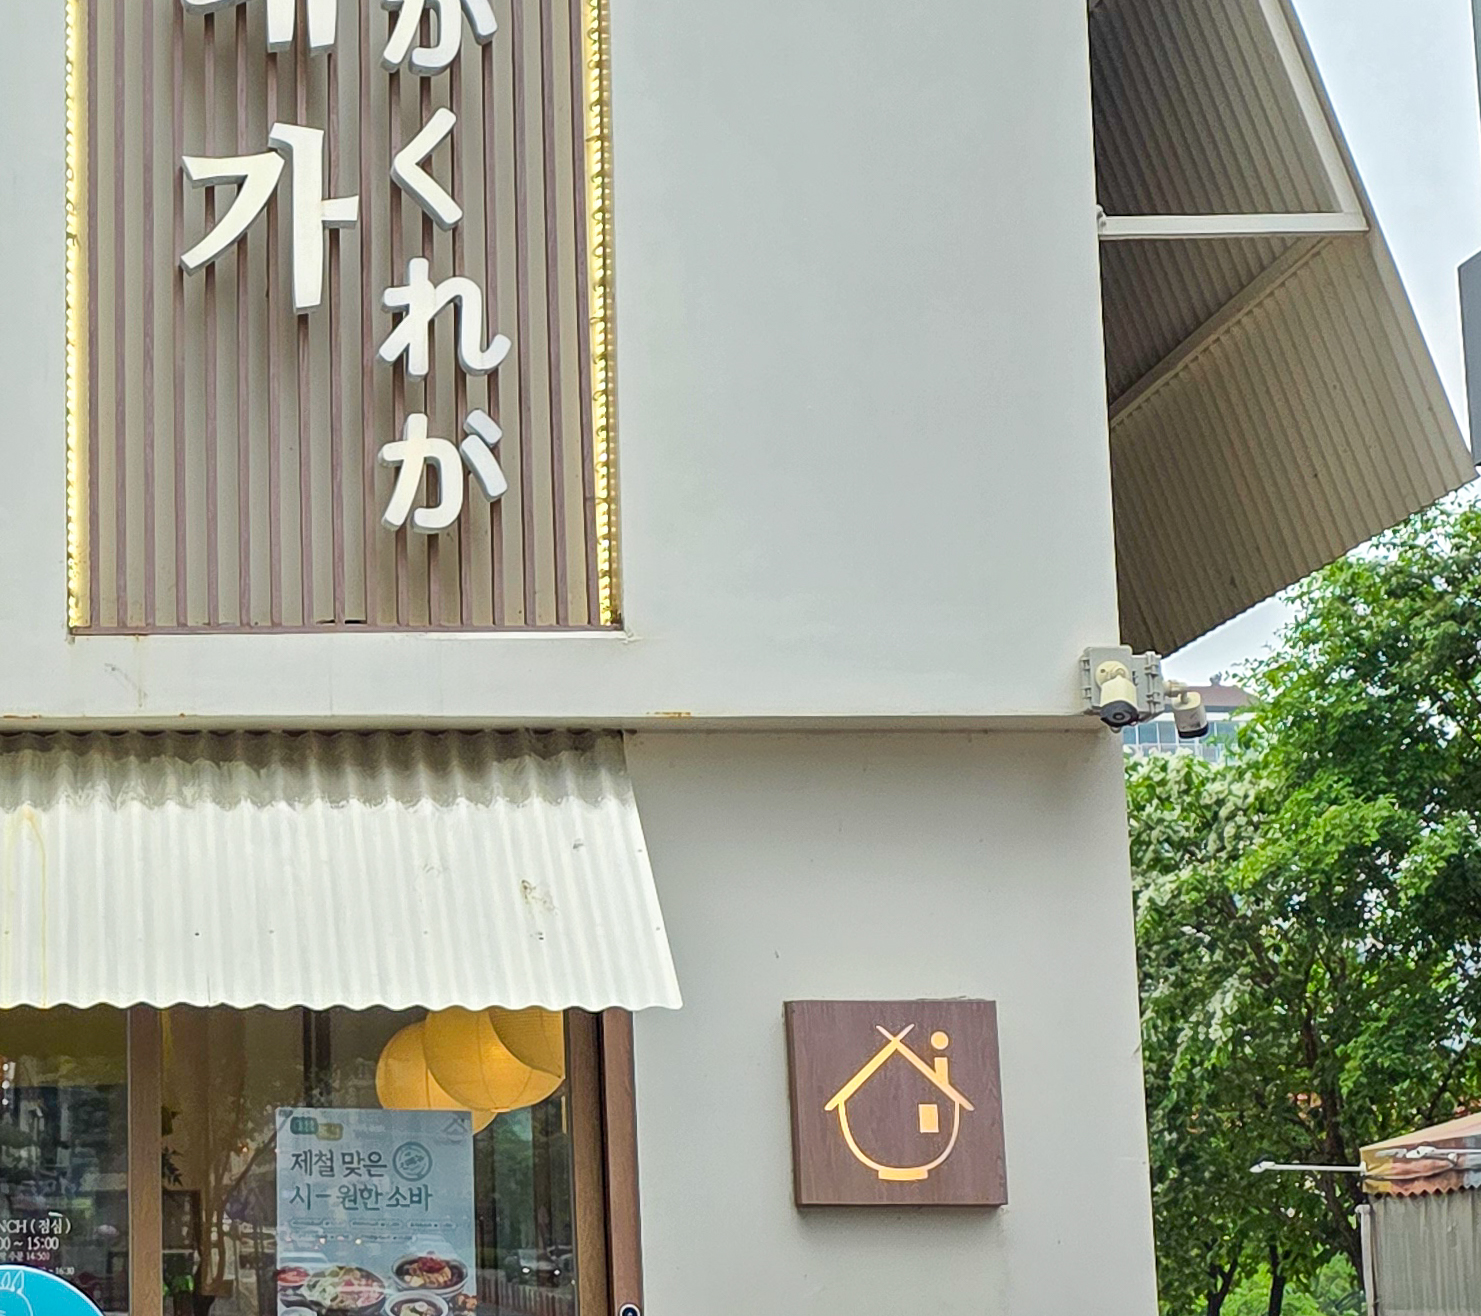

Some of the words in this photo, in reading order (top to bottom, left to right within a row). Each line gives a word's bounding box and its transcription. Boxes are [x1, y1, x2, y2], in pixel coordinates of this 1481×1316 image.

[290, 1149, 336, 1178] 제철
[386, 1184, 433, 1212] 소바
[27, 1236, 60, 1250] 15:00
